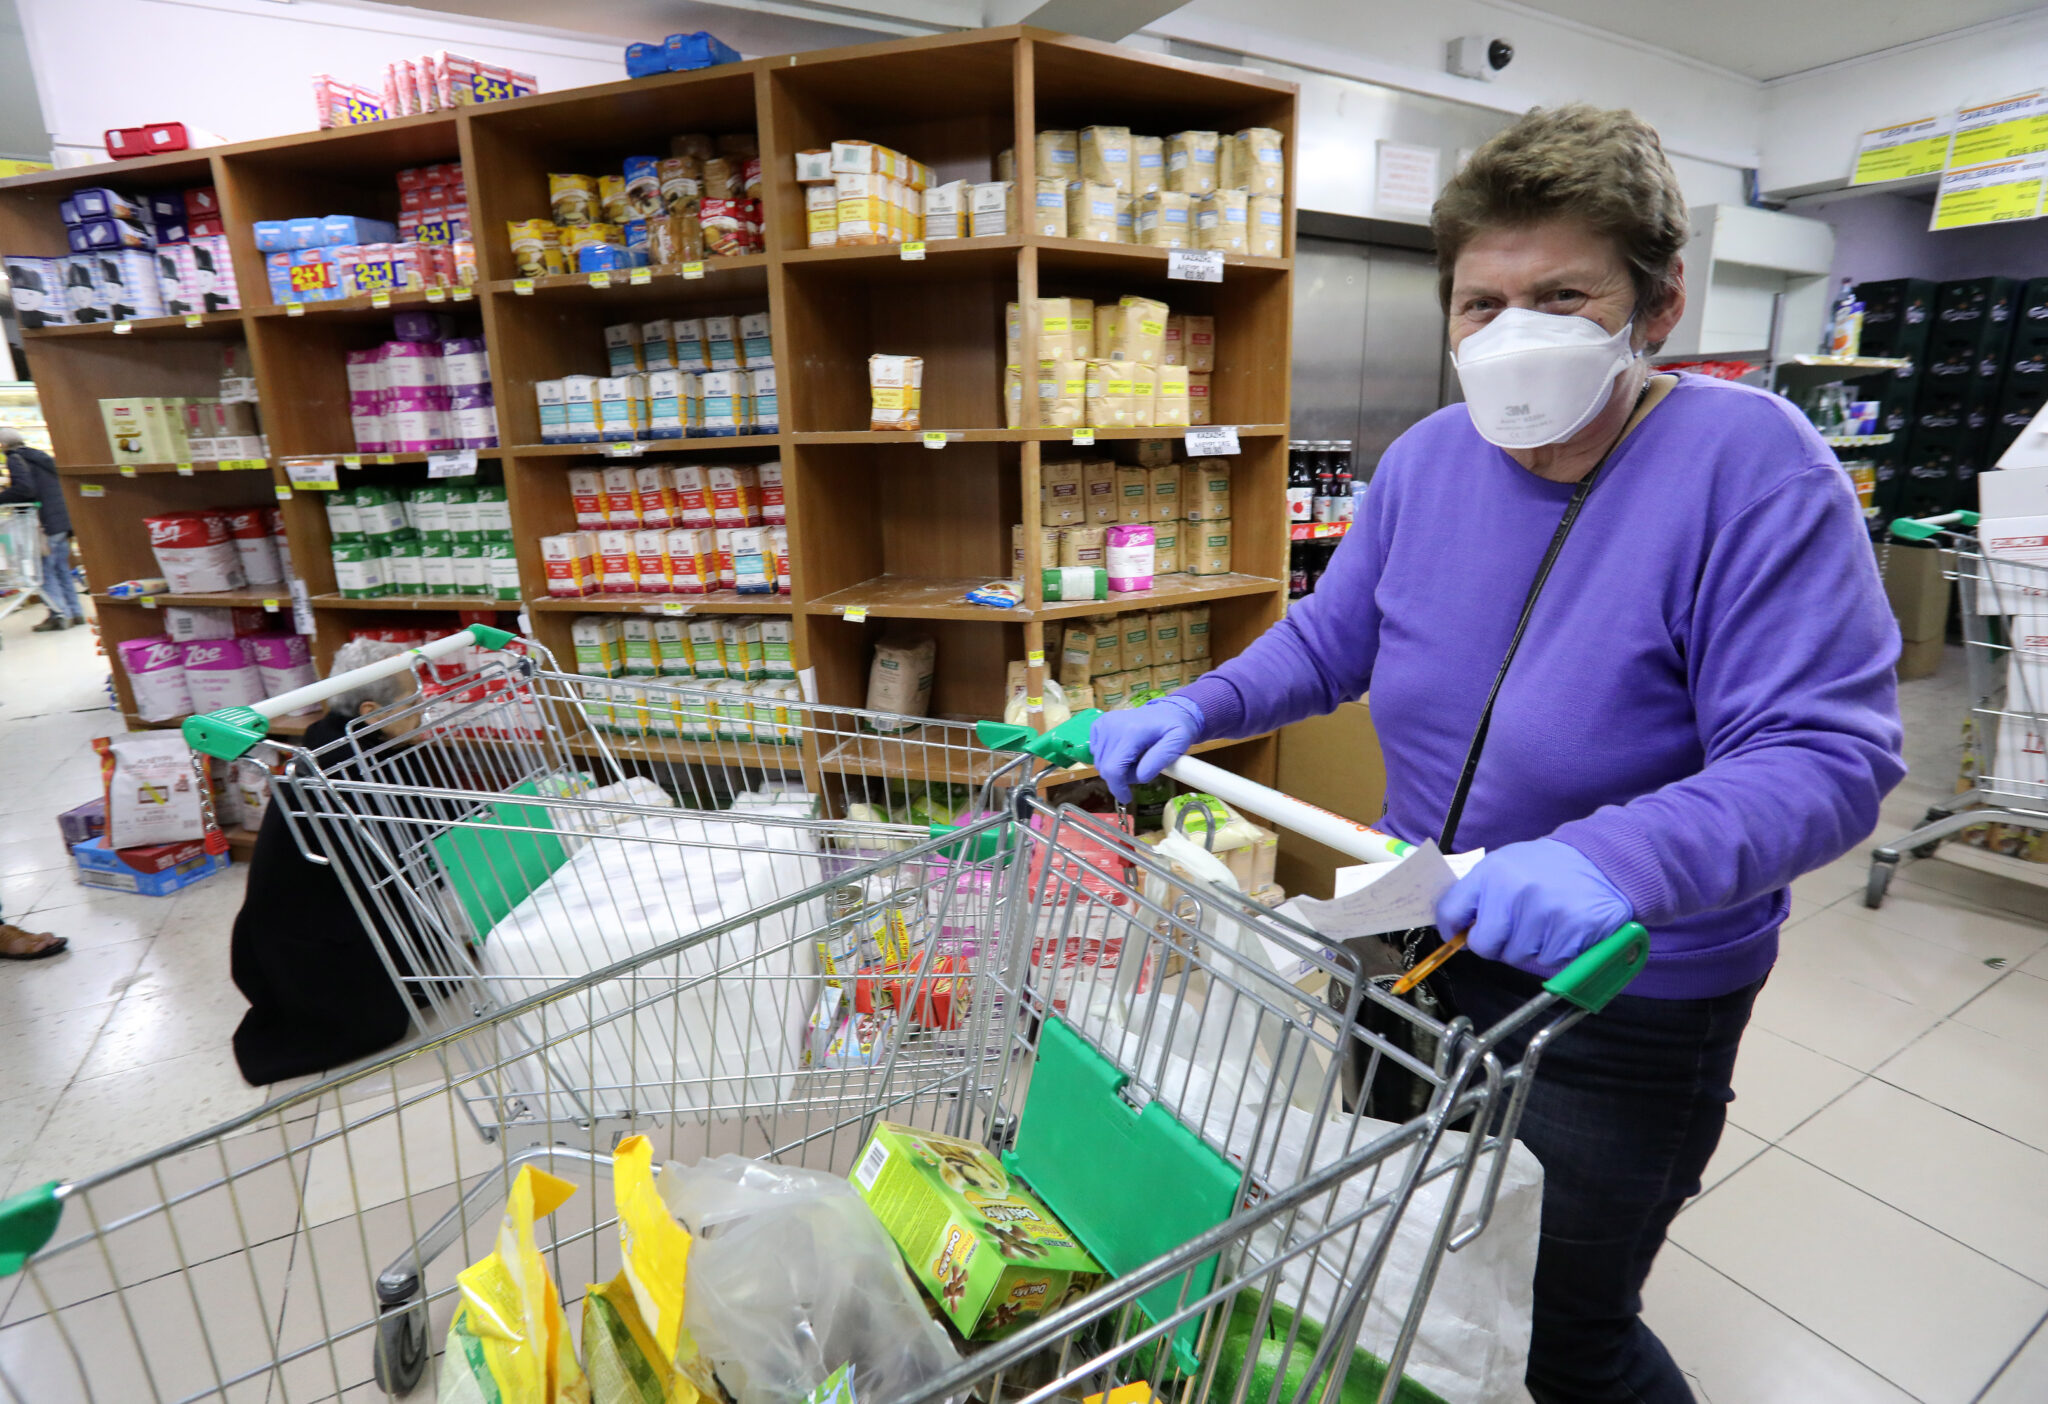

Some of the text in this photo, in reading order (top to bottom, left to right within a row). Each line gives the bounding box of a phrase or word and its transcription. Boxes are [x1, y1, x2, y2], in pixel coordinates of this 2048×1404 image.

[474, 75, 515, 100] 2+1
[349, 99, 384, 124] 2+1
[417, 221, 451, 243] 2+1
[291, 263, 326, 286] 2+1
[355, 261, 394, 284] 2+1
[1505, 404, 1530, 416] 3M
[144, 643, 180, 669] Zo
[185, 644, 224, 667] Zoe
[946, 1230, 961, 1254] Deli
